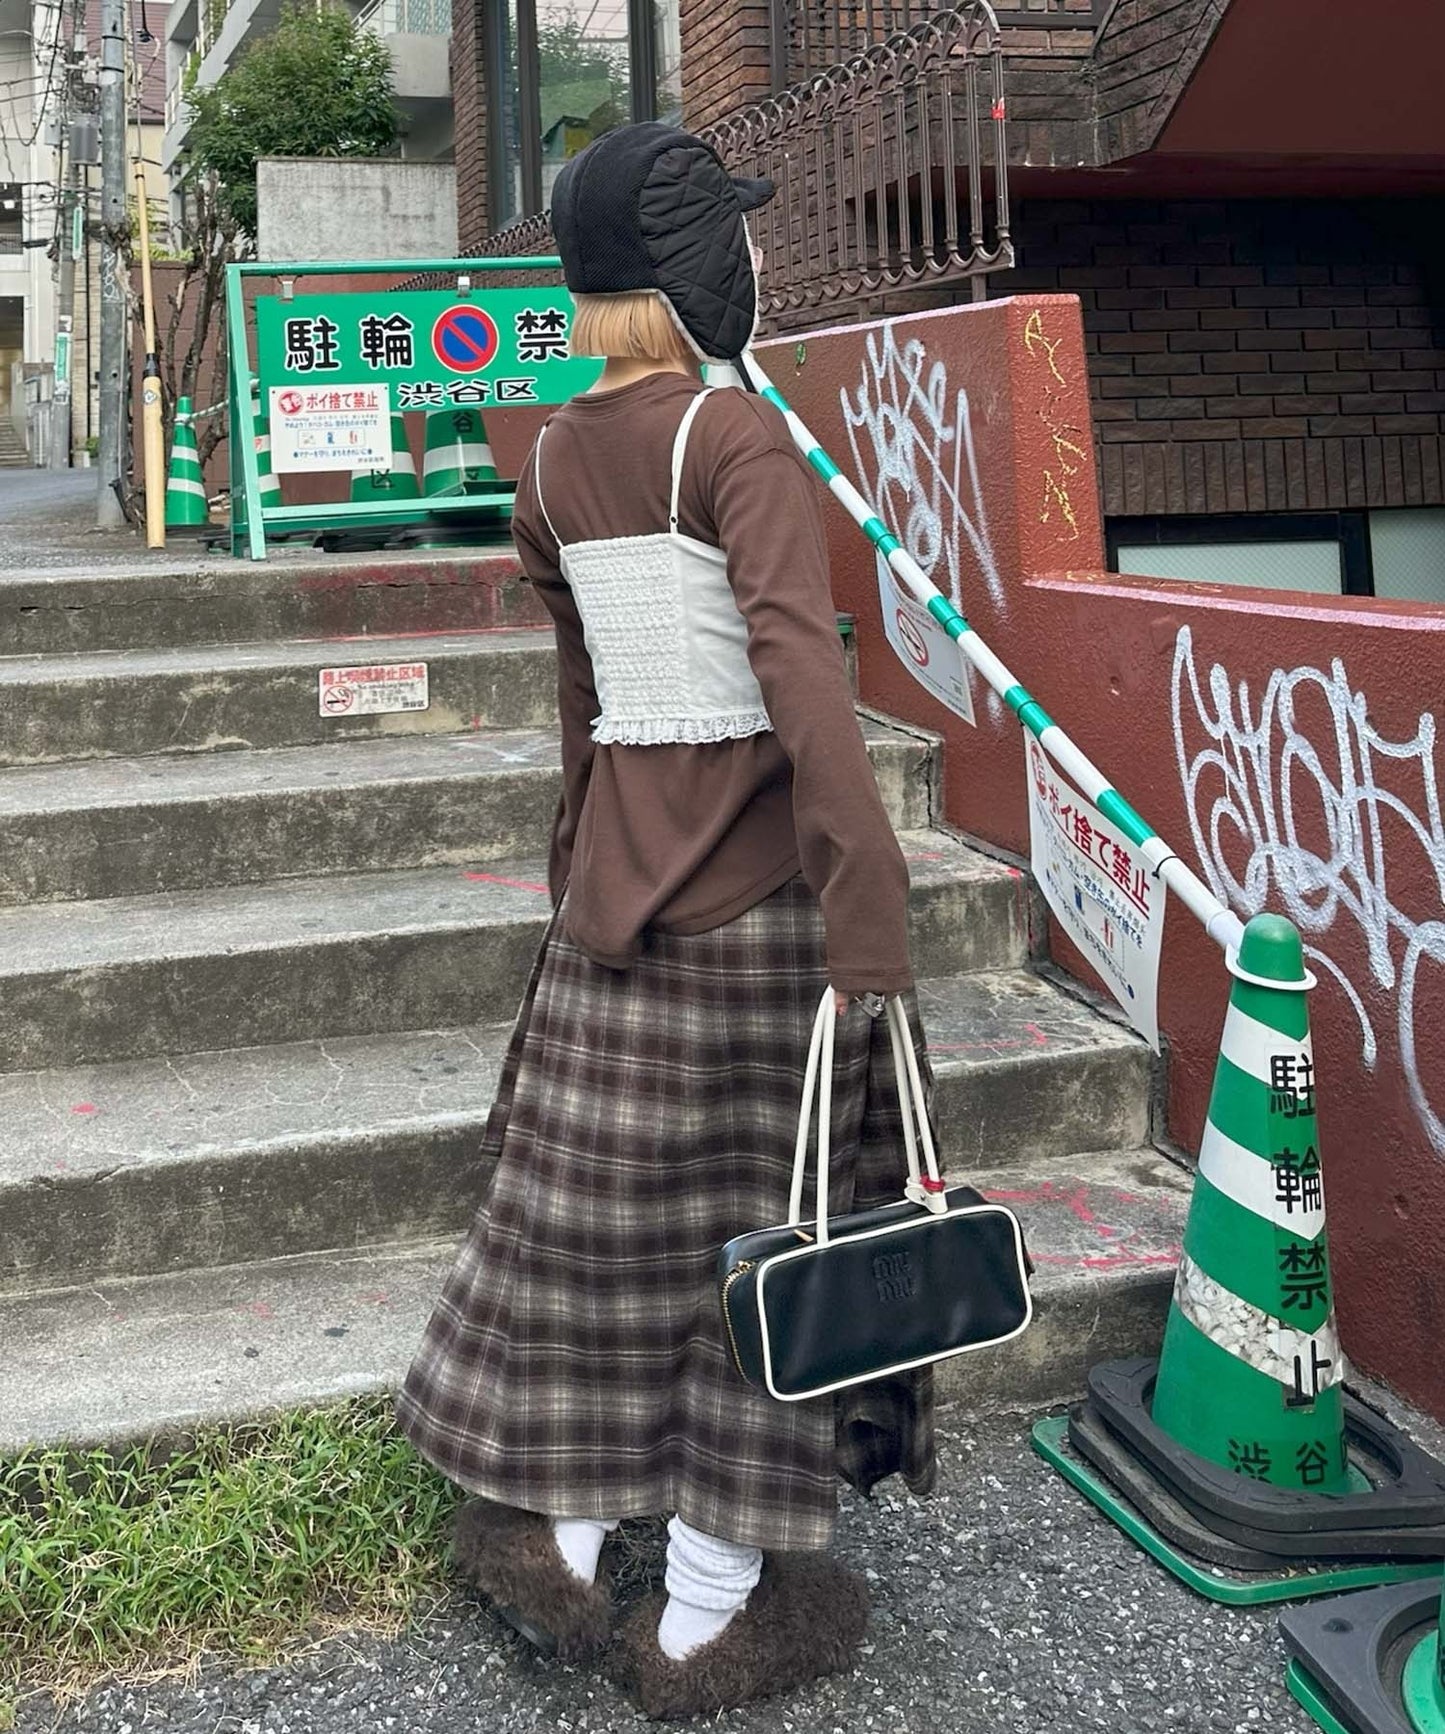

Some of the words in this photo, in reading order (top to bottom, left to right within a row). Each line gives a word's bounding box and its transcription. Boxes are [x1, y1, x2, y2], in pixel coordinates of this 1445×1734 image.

[306, 391, 379, 409] ポイ捨て禁止
[400, 377, 538, 407] 渋谷区
[1049, 784, 1149, 911] ポイ捨て禁止
[1270, 1053, 1331, 1407] 駐輪禁止
